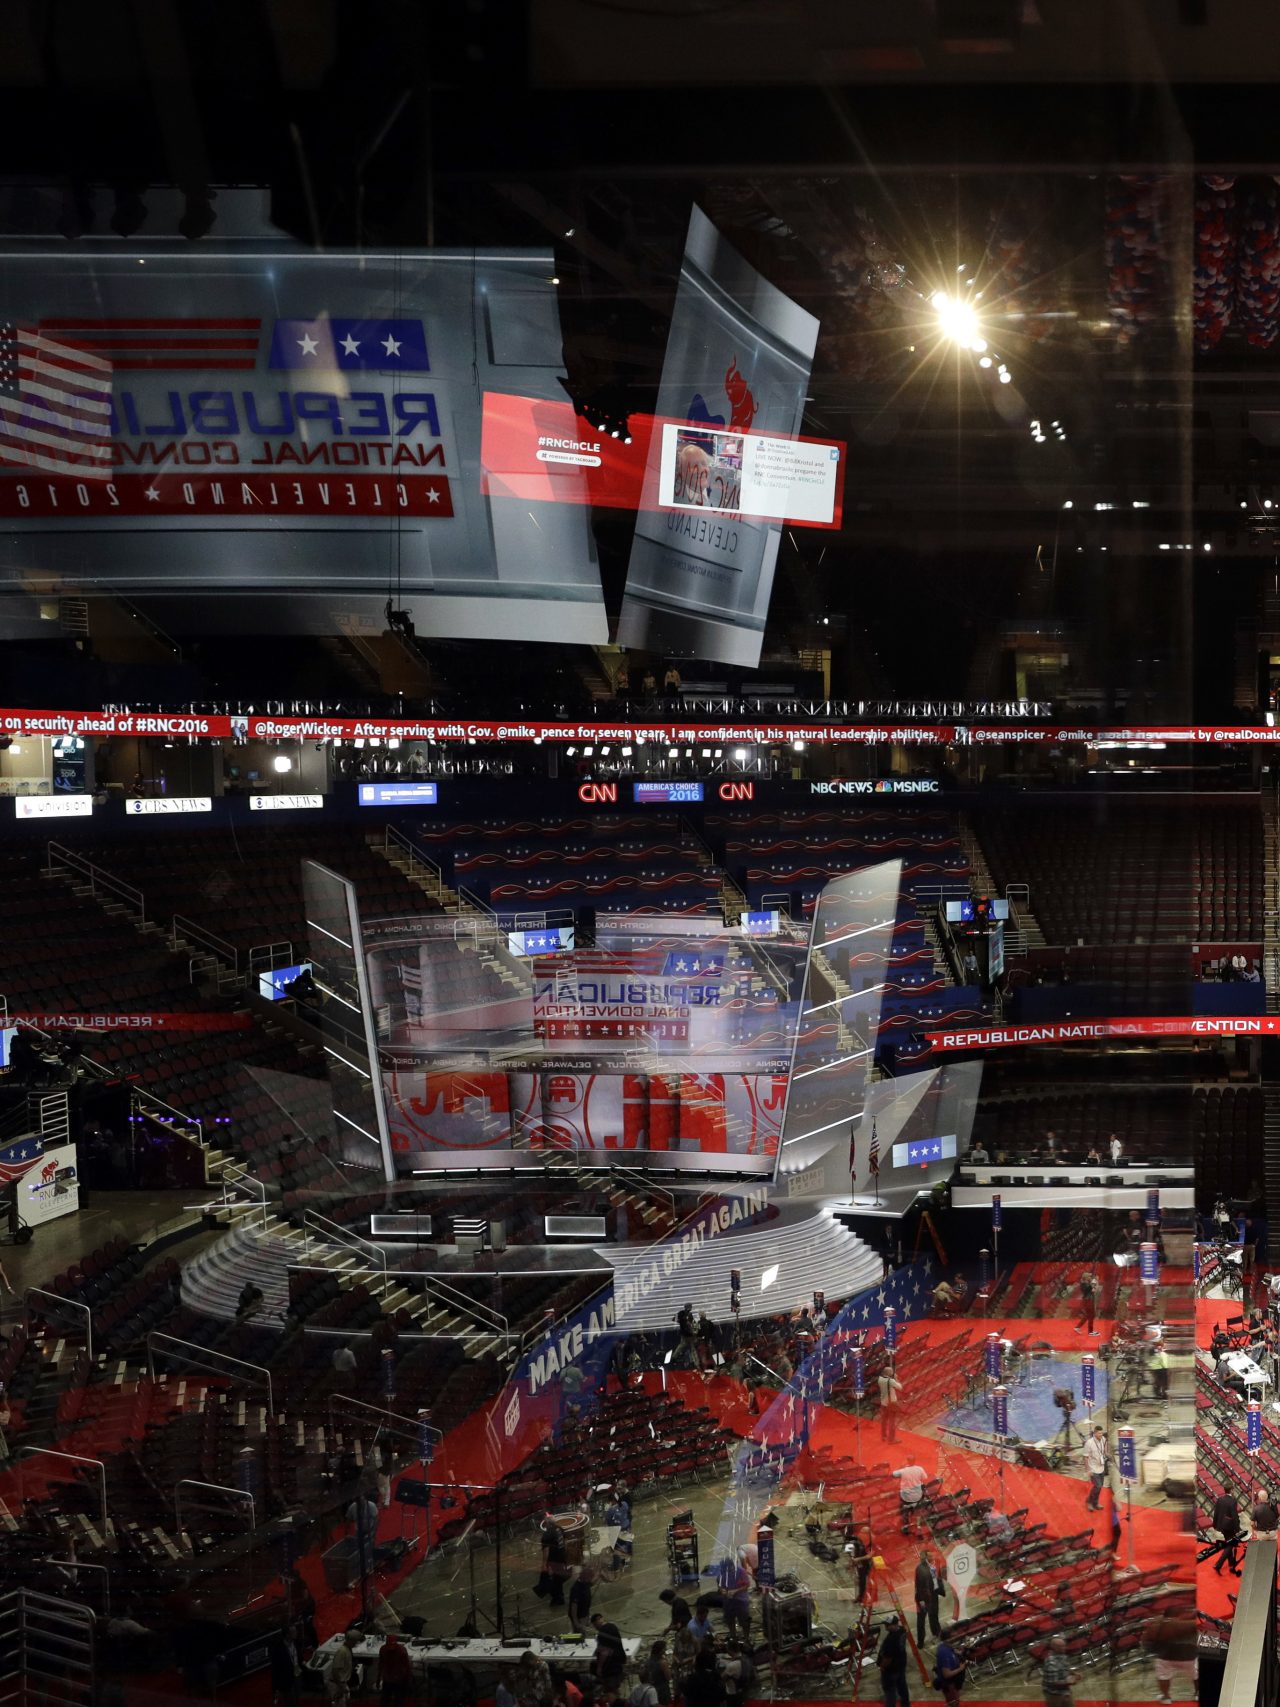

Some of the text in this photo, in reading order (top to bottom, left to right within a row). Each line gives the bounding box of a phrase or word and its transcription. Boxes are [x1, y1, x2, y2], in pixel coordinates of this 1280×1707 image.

[538, 437, 601, 452] #RNCinCLE
[6, 715, 209, 734] on security ahead of #RNC2016
[255, 722, 344, 737] @RogerWicker
[354, 723, 387, 736] After
[390, 725, 434, 739] serving
[437, 725, 465, 737] with
[468, 726, 494, 738] Gov.
[578, 727, 596, 738] for
[598, 729, 632, 738] seven
[678, 731, 696, 739] am
[698, 727, 753, 739] confident
[755, 728, 765, 739] in
[767, 728, 784, 739] his
[786, 729, 827, 740] natural
[831, 728, 888, 742] leadership
[975, 730, 1046, 742] @seanspicer
[1198, 730, 1211, 742] by
[578, 783, 617, 802] CNN
[638, 783, 674, 791] AMERICA'S
[719, 782, 753, 801] CNN
[810, 781, 939, 794] NBC NEWS MSNBC
[287, 796, 320, 808] NEWS
[669, 791, 700, 801] 2016
[145, 799, 208, 813] CBS NEWS
[943, 1028, 1055, 1047] REPUBLICAN
[1059, 1023, 1144, 1039] NATIONAL
[530, 1186, 769, 1394] MAKE AMERICA GREAT AGAIN!
